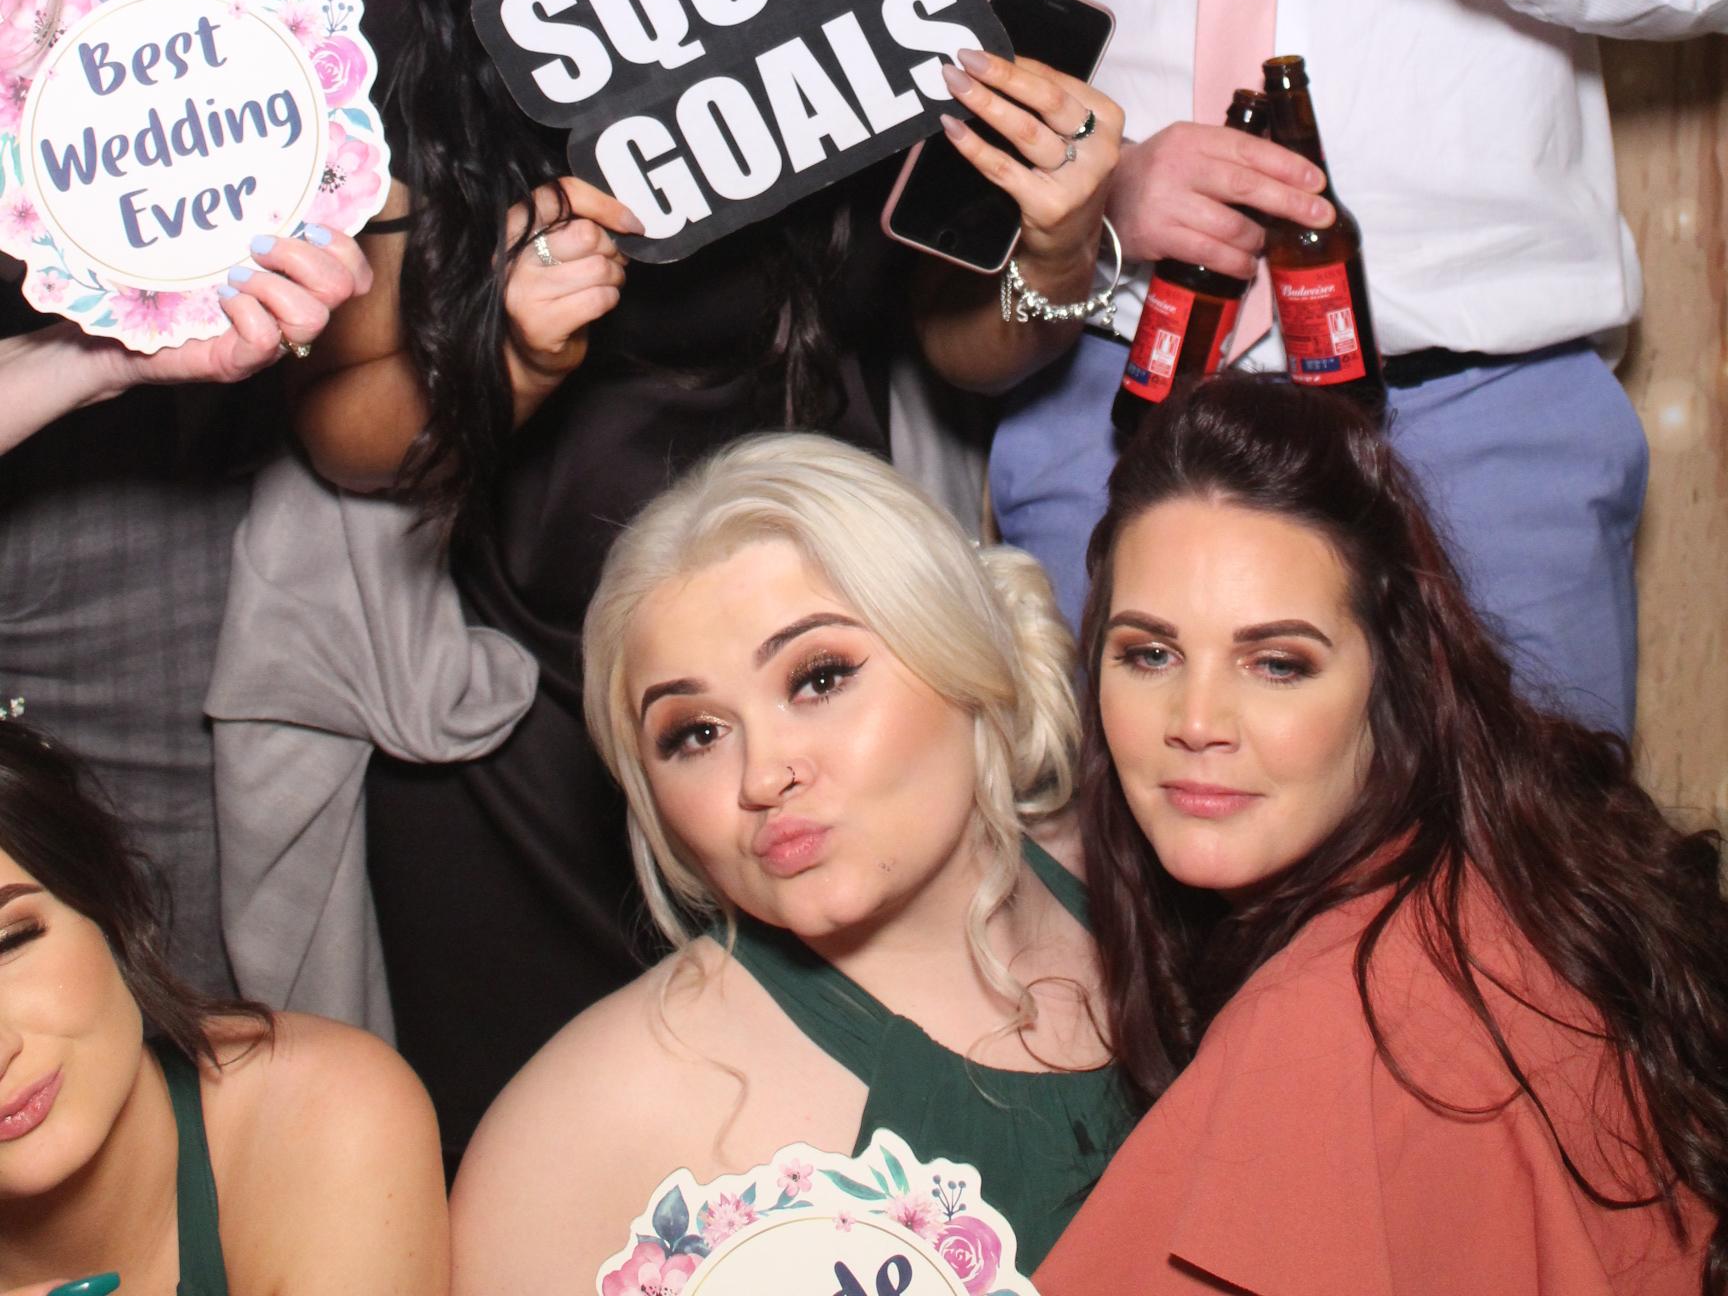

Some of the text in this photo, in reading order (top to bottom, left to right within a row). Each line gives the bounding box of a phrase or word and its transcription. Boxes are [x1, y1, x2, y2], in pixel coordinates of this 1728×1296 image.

[78, 16, 228, 96] Best
[40, 88, 302, 193] Wedding
[118, 175, 257, 249] Ever
[1280, 284, 1336, 297] Budweiser
